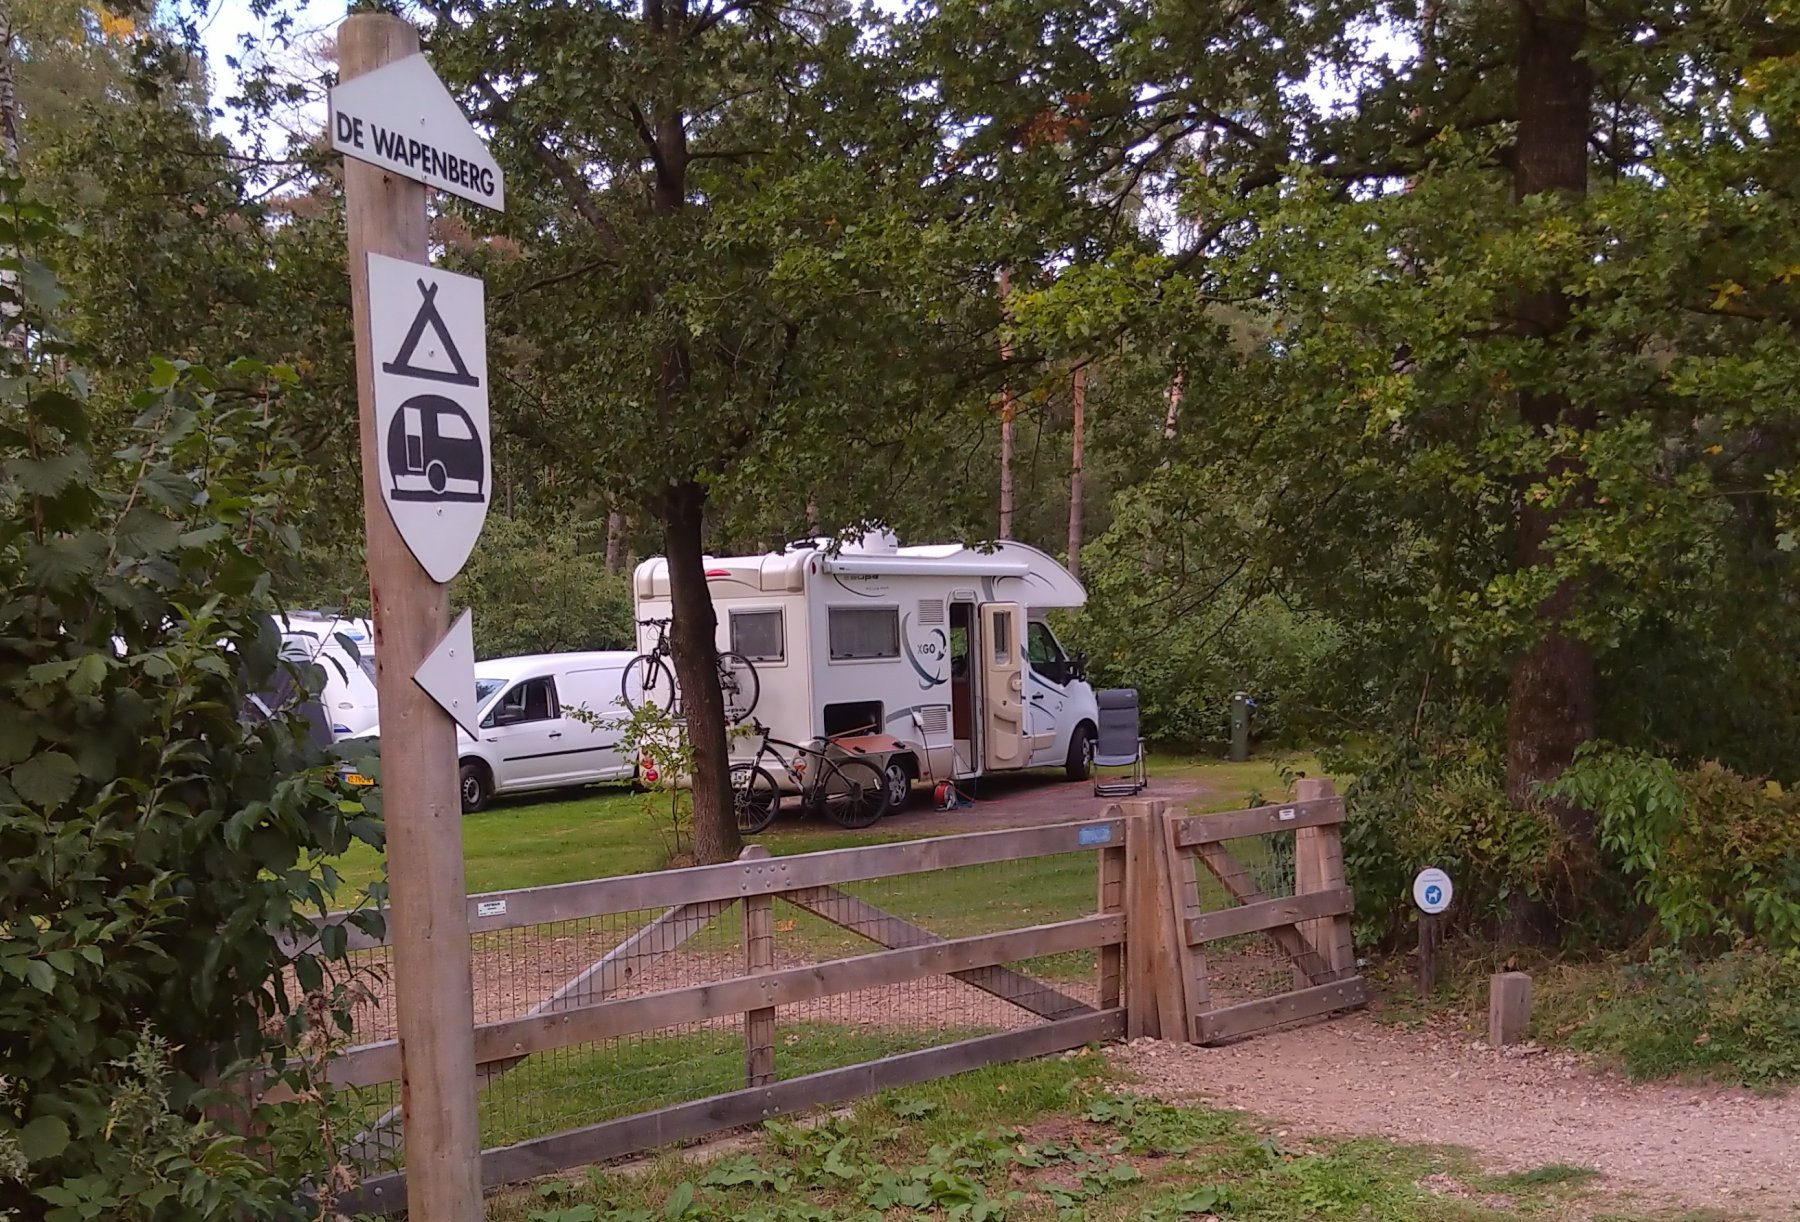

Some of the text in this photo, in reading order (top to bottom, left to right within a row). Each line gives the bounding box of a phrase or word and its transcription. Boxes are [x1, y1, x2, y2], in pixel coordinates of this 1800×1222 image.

[336, 110, 495, 197] DE WAPENBERG
[917, 643, 936, 655] XGO
